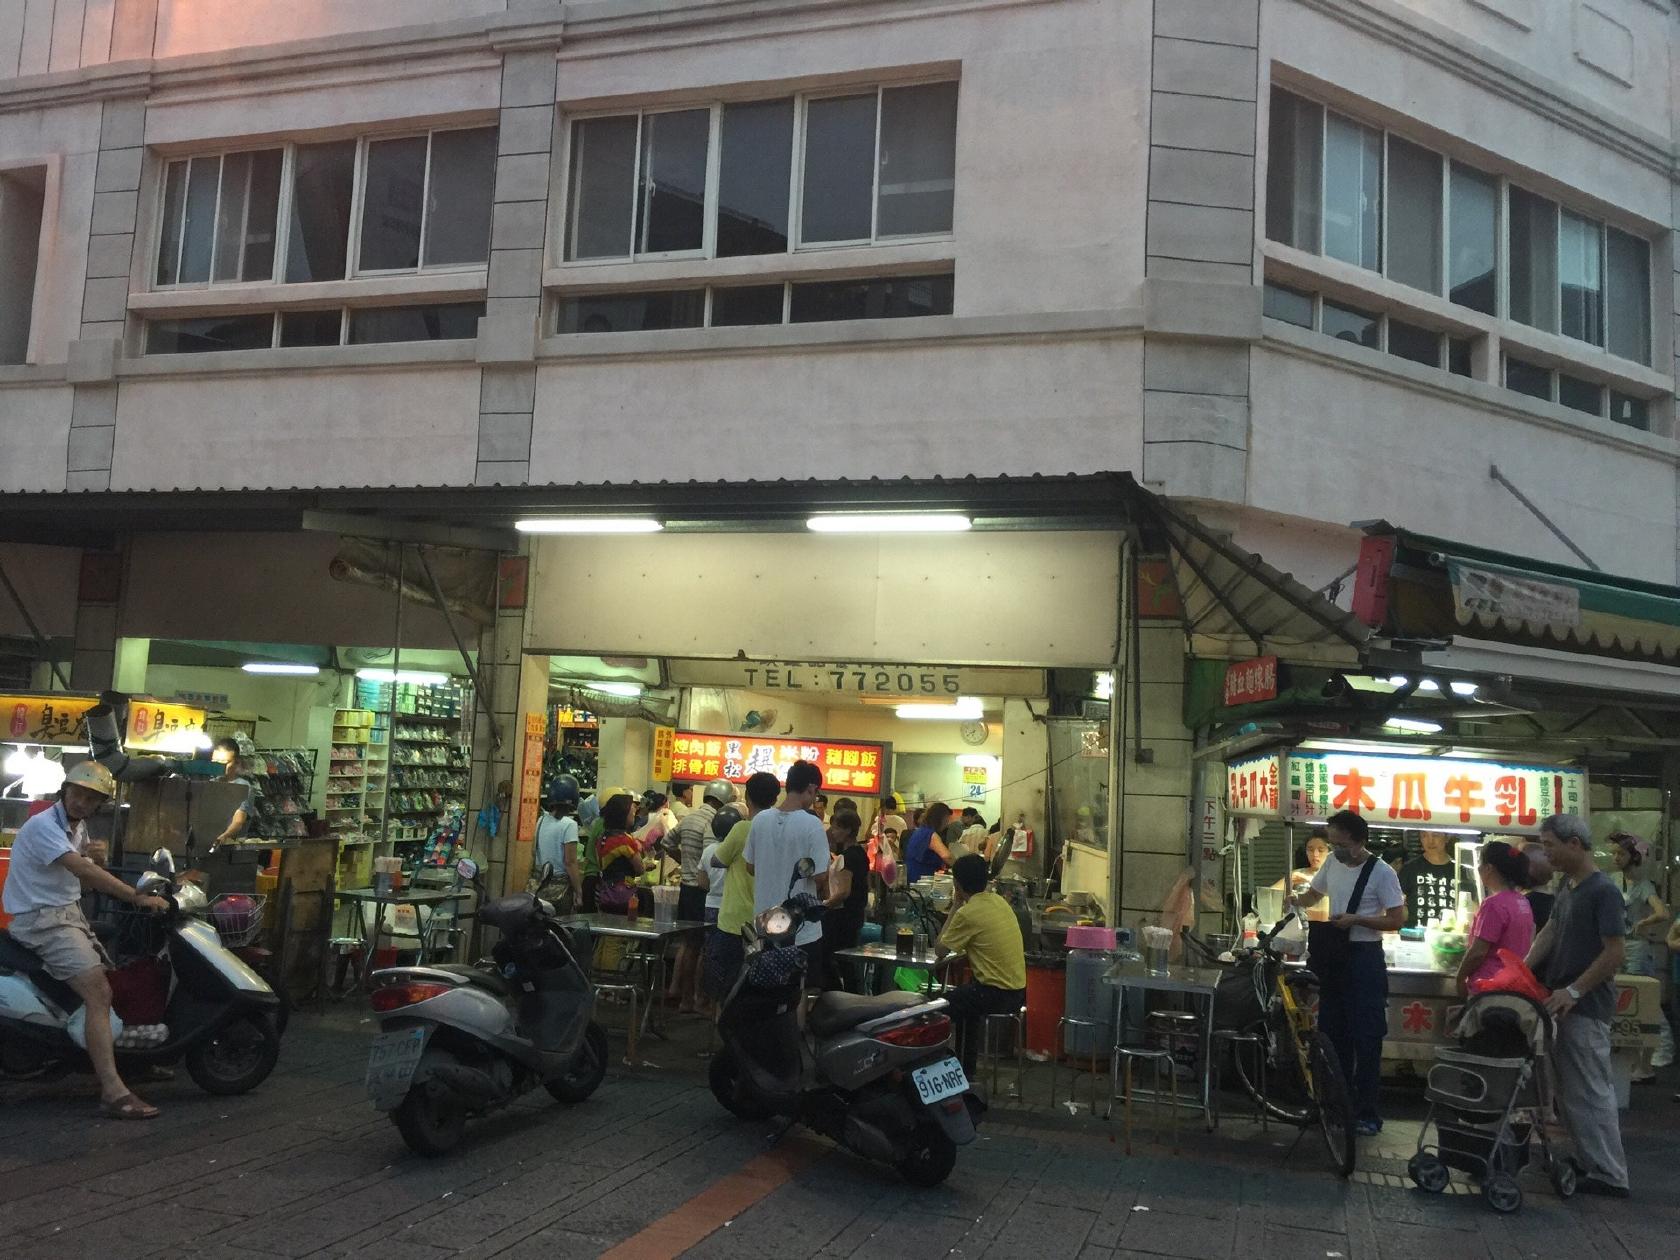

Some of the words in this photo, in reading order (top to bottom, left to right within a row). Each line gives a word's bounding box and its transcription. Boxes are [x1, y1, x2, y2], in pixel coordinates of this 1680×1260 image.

[672, 758, 720, 776] 排骨飯
[826, 768, 876, 788] 便當
[1333, 767, 1538, 826] 木瓜牛乳
[1540, 776, 1551, 821] 綠豆沙牛
